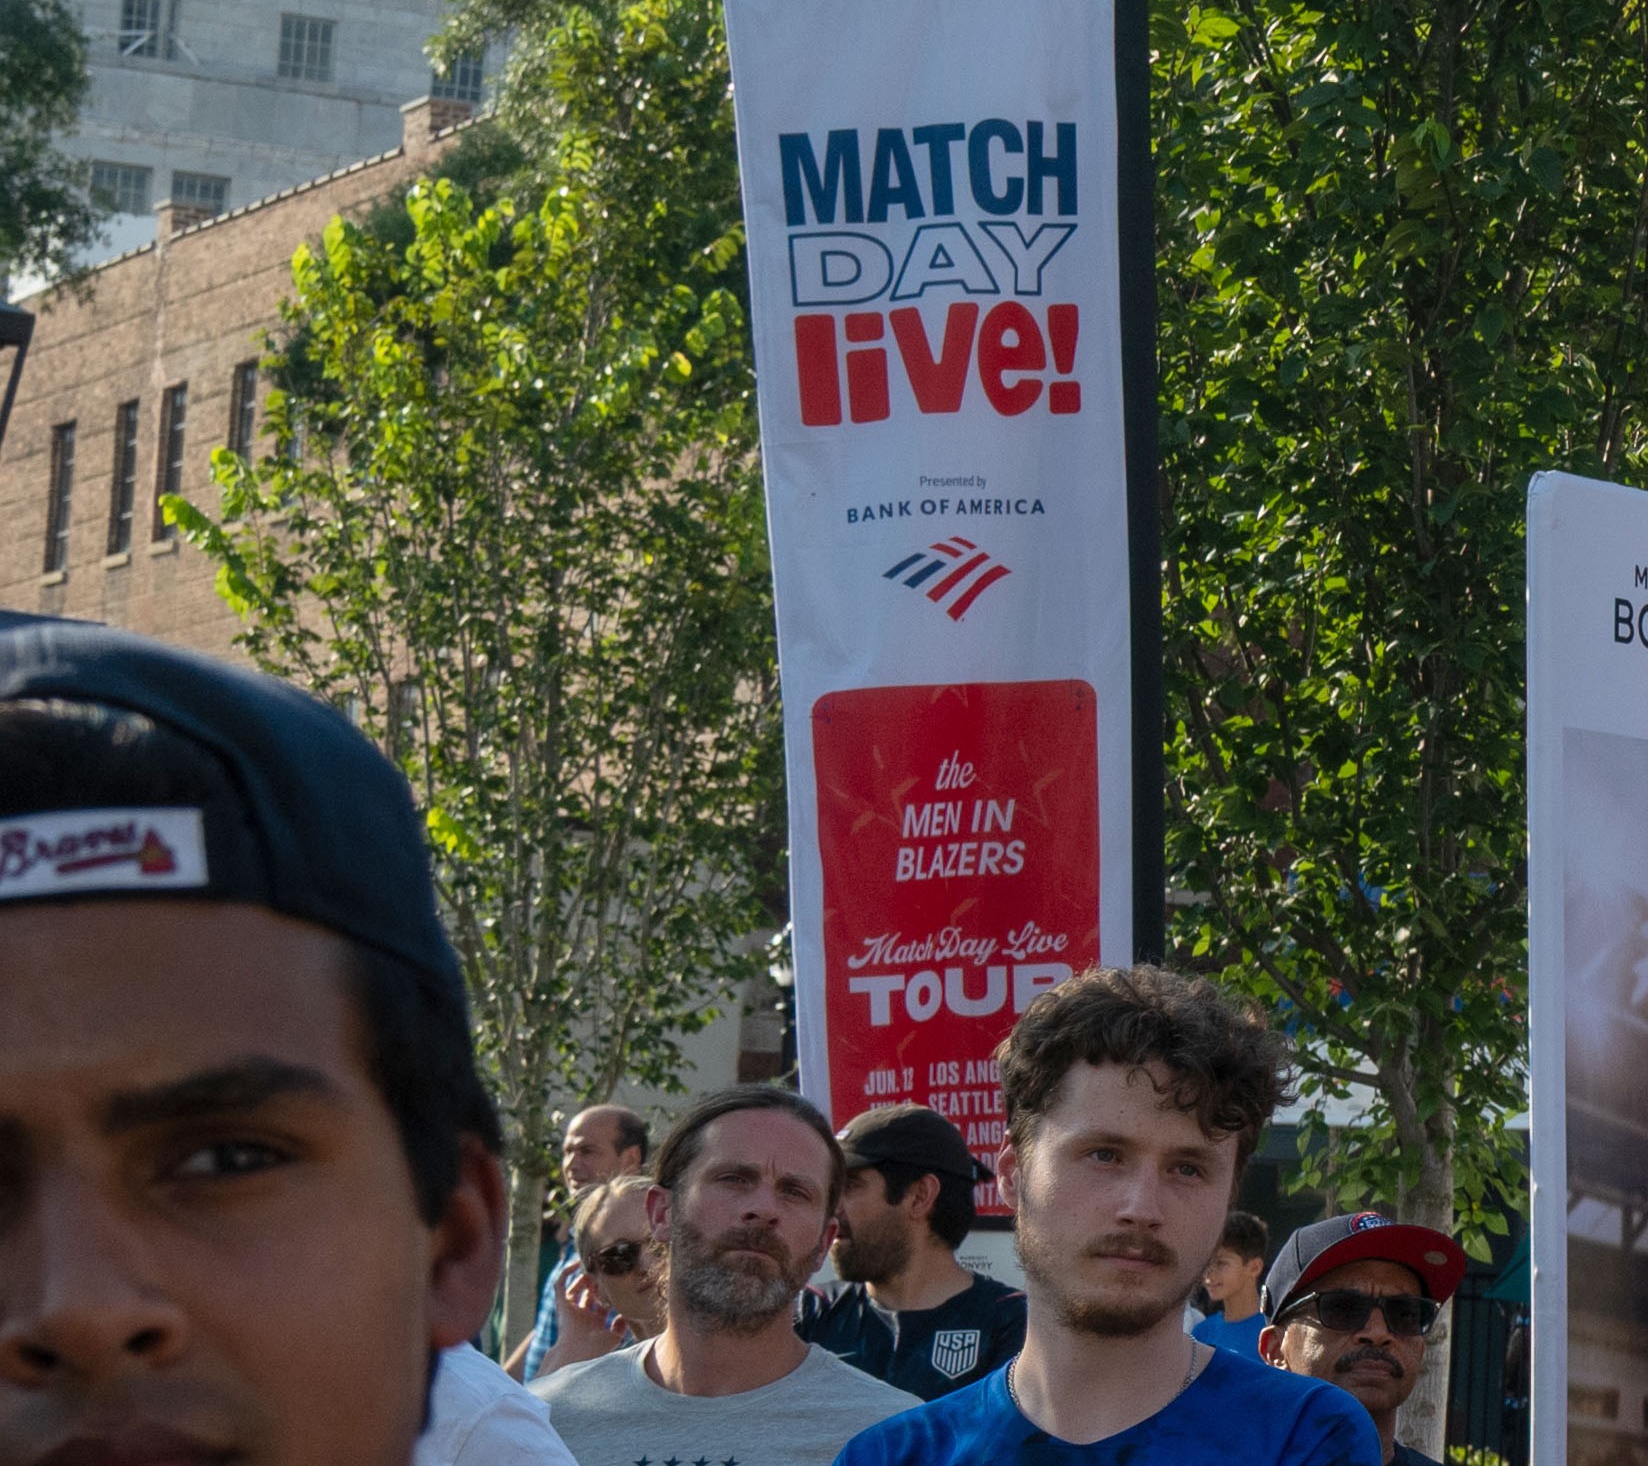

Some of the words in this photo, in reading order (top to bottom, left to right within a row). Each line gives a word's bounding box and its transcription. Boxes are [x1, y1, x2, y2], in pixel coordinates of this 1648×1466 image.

[779, 118, 1077, 227] MATCH
[789, 222, 1077, 306] DAY
[795, 302, 1081, 426] live!
[920, 475, 974, 487] Presented
[976, 475, 986, 489] by
[847, 500, 912, 524] BANK
[920, 499, 949, 515] OF
[956, 499, 1045, 515] AMERICA
[935, 750, 976, 791] the
[902, 800, 962, 839] MEN
[971, 799, 1015, 833] IN
[895, 840, 1025, 882] BLAZERS
[848, 933, 934, 969] Match
[934, 926, 999, 965] Day
[1002, 921, 1069, 960] Live
[864, 1069, 899, 1096] JUN.
[928, 1061, 959, 1086] LOS
[928, 1090, 1003, 1116] SEATTLE
[939, 1333, 976, 1350] USA
